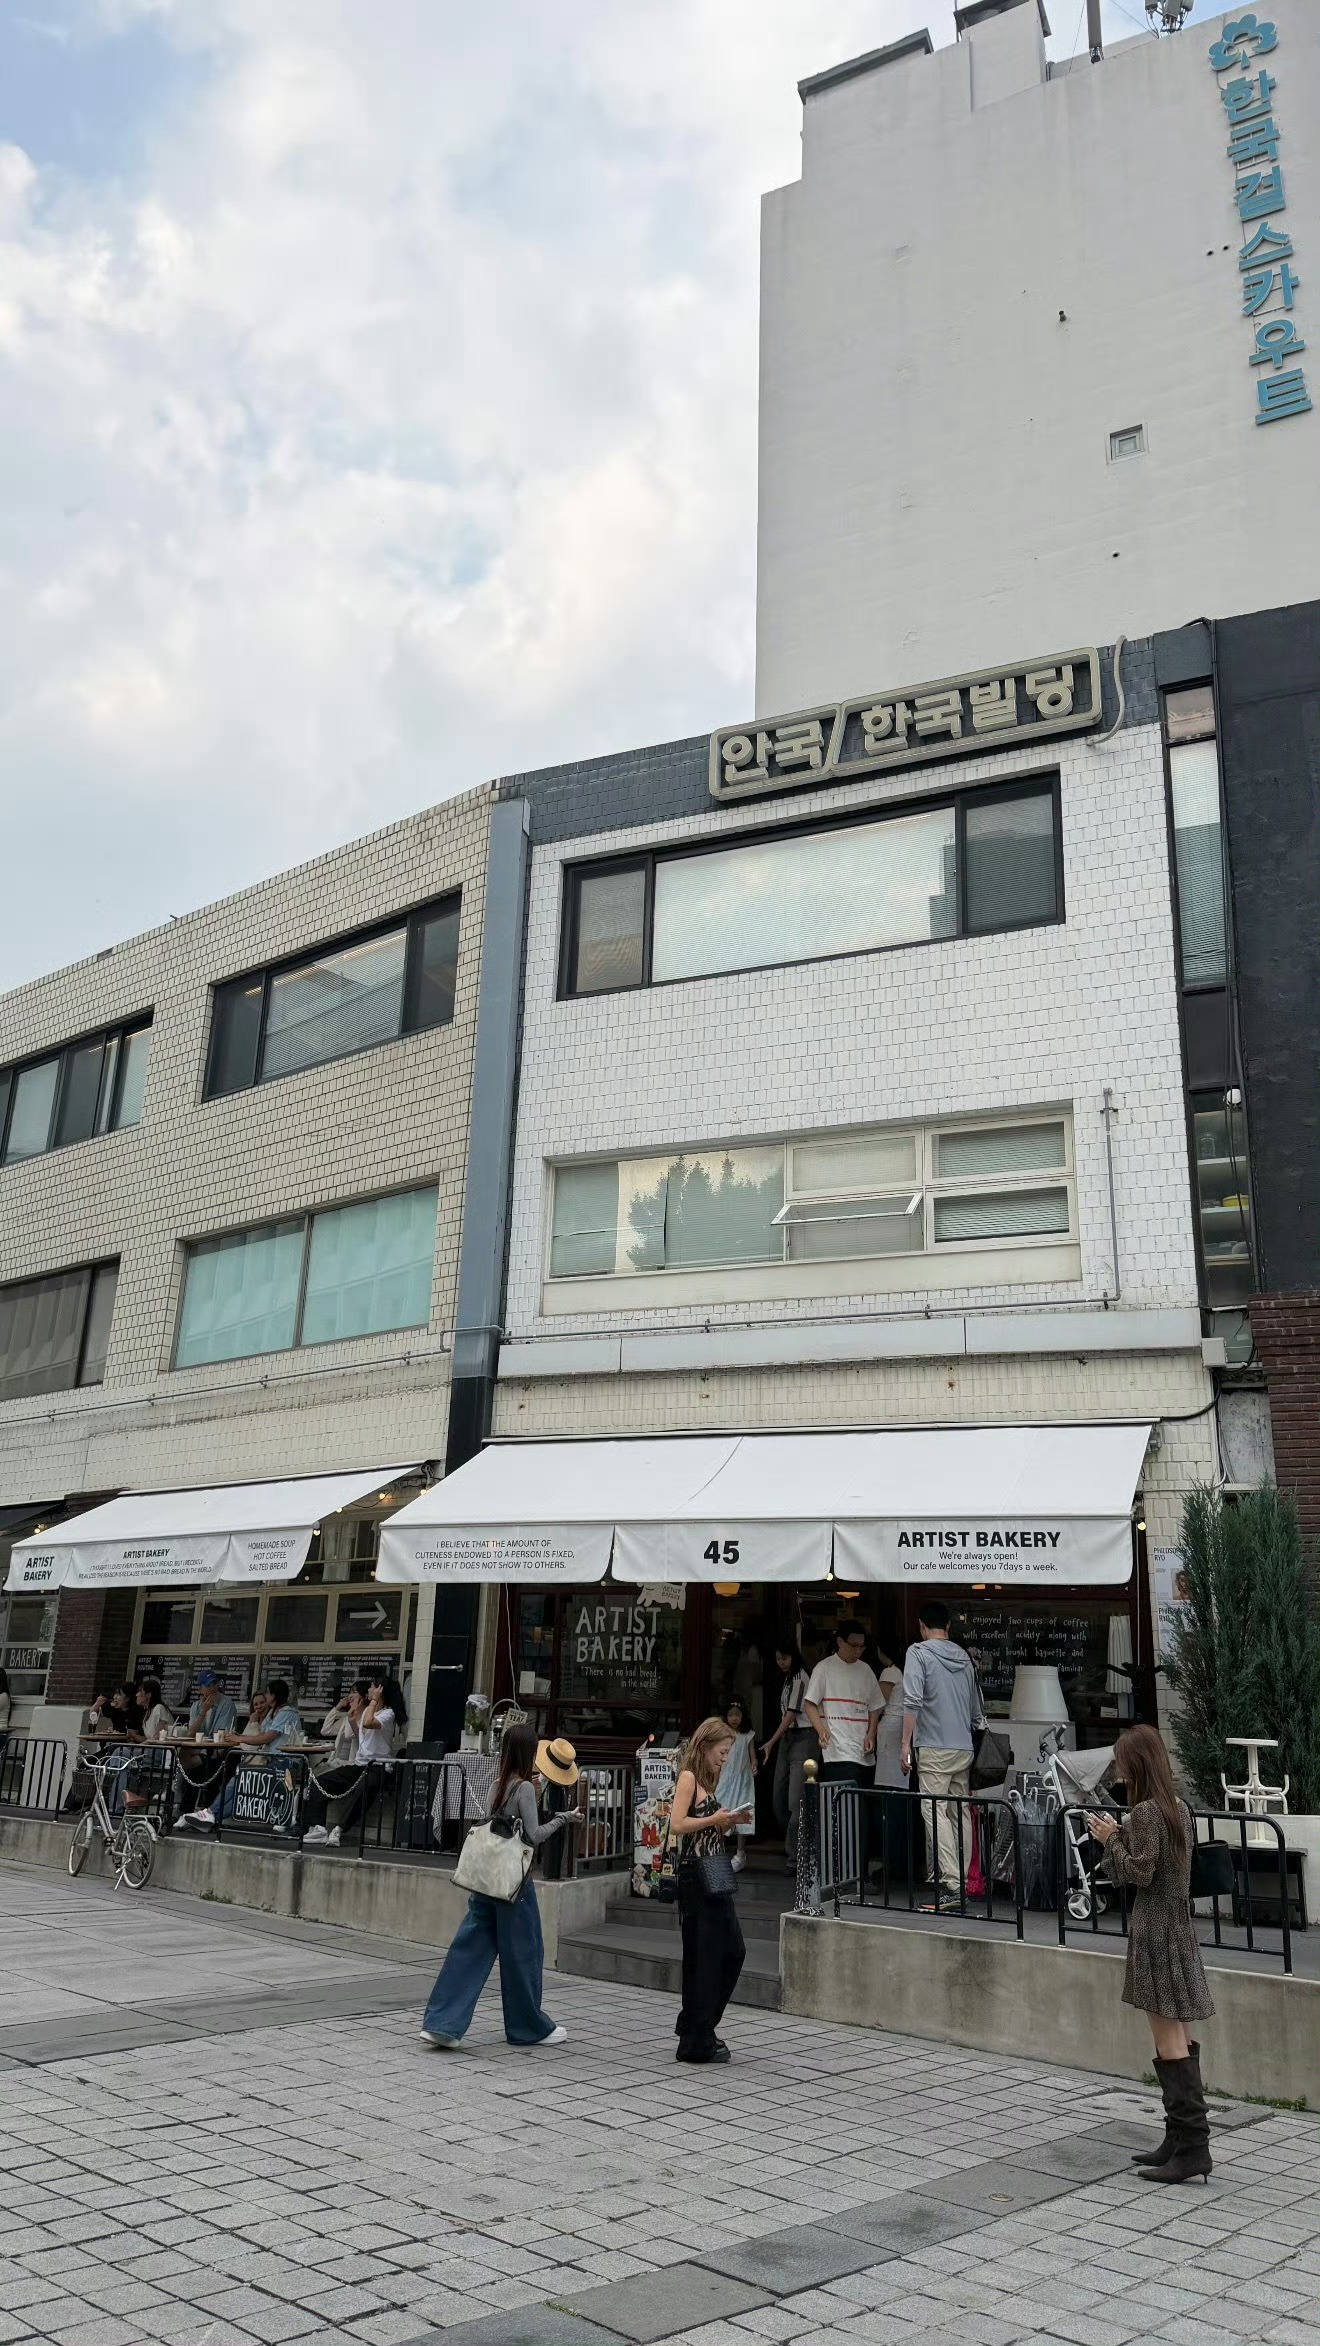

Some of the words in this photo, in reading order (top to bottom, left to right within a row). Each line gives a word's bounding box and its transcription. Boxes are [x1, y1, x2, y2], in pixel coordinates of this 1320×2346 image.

[1220, 69, 1312, 426] 한국걸스카우트
[721, 720, 824, 785] 안국
[248, 1540, 280, 1550] HOMEMADE
[280, 1539, 296, 1548] SOUP
[440, 1540, 470, 1548] BELIEVE
[471, 1540, 490, 1548] THAT
[491, 1540, 506, 1548] THE
[506, 1540, 540, 1548] AMOUNT
[540, 1539, 552, 1547] OF
[897, 1531, 970, 1547] ARTIST
[975, 1531, 1061, 1547] BAKERY
[123, 1549, 145, 1559] ARTIST
[145, 1548, 170, 1558] BAKERY
[253, 1552, 265, 1561] HOT
[265, 1551, 287, 1560] COFFEE
[414, 1551, 453, 1559] CUTENESS
[453, 1551, 492, 1559] ENDOWED
[493, 1550, 503, 1558] TO
[504, 1550, 510, 1558] A
[510, 1550, 542, 1558] PERSON
[542, 1550, 551, 1558] IS
[551, 1550, 575, 1559] FIXED,
[703, 1540, 740, 1565] 45
[939, 1551, 962, 1560] We're
[964, 1551, 992, 1562] always
[993, 1551, 1018, 1562] open!
[26, 1556, 55, 1568] ARTIST
[248, 1563, 269, 1571] SALTED
[269, 1561, 288, 1570] BREAD
[423, 1562, 442, 1570] EVEN
[443, 1561, 450, 1569] IF
[451, 1561, 459, 1569] IT
[460, 1561, 481, 1569] DOES
[481, 1561, 498, 1569] NOT
[498, 1561, 521, 1569] SHOW
[522, 1561, 533, 1569] TO
[534, 1561, 567, 1569] OTHERS.
[903, 1561, 918, 1570] Our
[920, 1561, 937, 1570] cafe
[938, 1561, 980, 1570] welcomes
[981, 1563, 997, 1572] you
[998, 1562, 1024, 1572] 7days
[1032, 1562, 1058, 1571] week.
[24, 1570, 53, 1581] BAKERY
[575, 1606, 662, 1635] ARTIST
[972, 1613, 1001, 1626] enjoyed
[1008, 1616, 1021, 1625] two
[1026, 1617, 1043, 1626] cups
[1049, 1617, 1058, 1627] of
[1063, 1617, 1088, 1628] coffee
[981, 1630, 1008, 1639] excellent
[1015, 1629, 1040, 1642] acidity
[1048, 1629, 1067, 1642] along
[1071, 1630, 1087, 1641] with
[576, 1635, 657, 1663] BAKERY
[1071, 1647, 1084, 1657] and
[9, 1648, 43, 1668] BAKERY
[625, 1665, 637, 1677] bad
[644, 1764, 671, 1772] ARTIST
[237, 1770, 274, 1798] ARTIST
[235, 1794, 270, 1820] BAKERY
